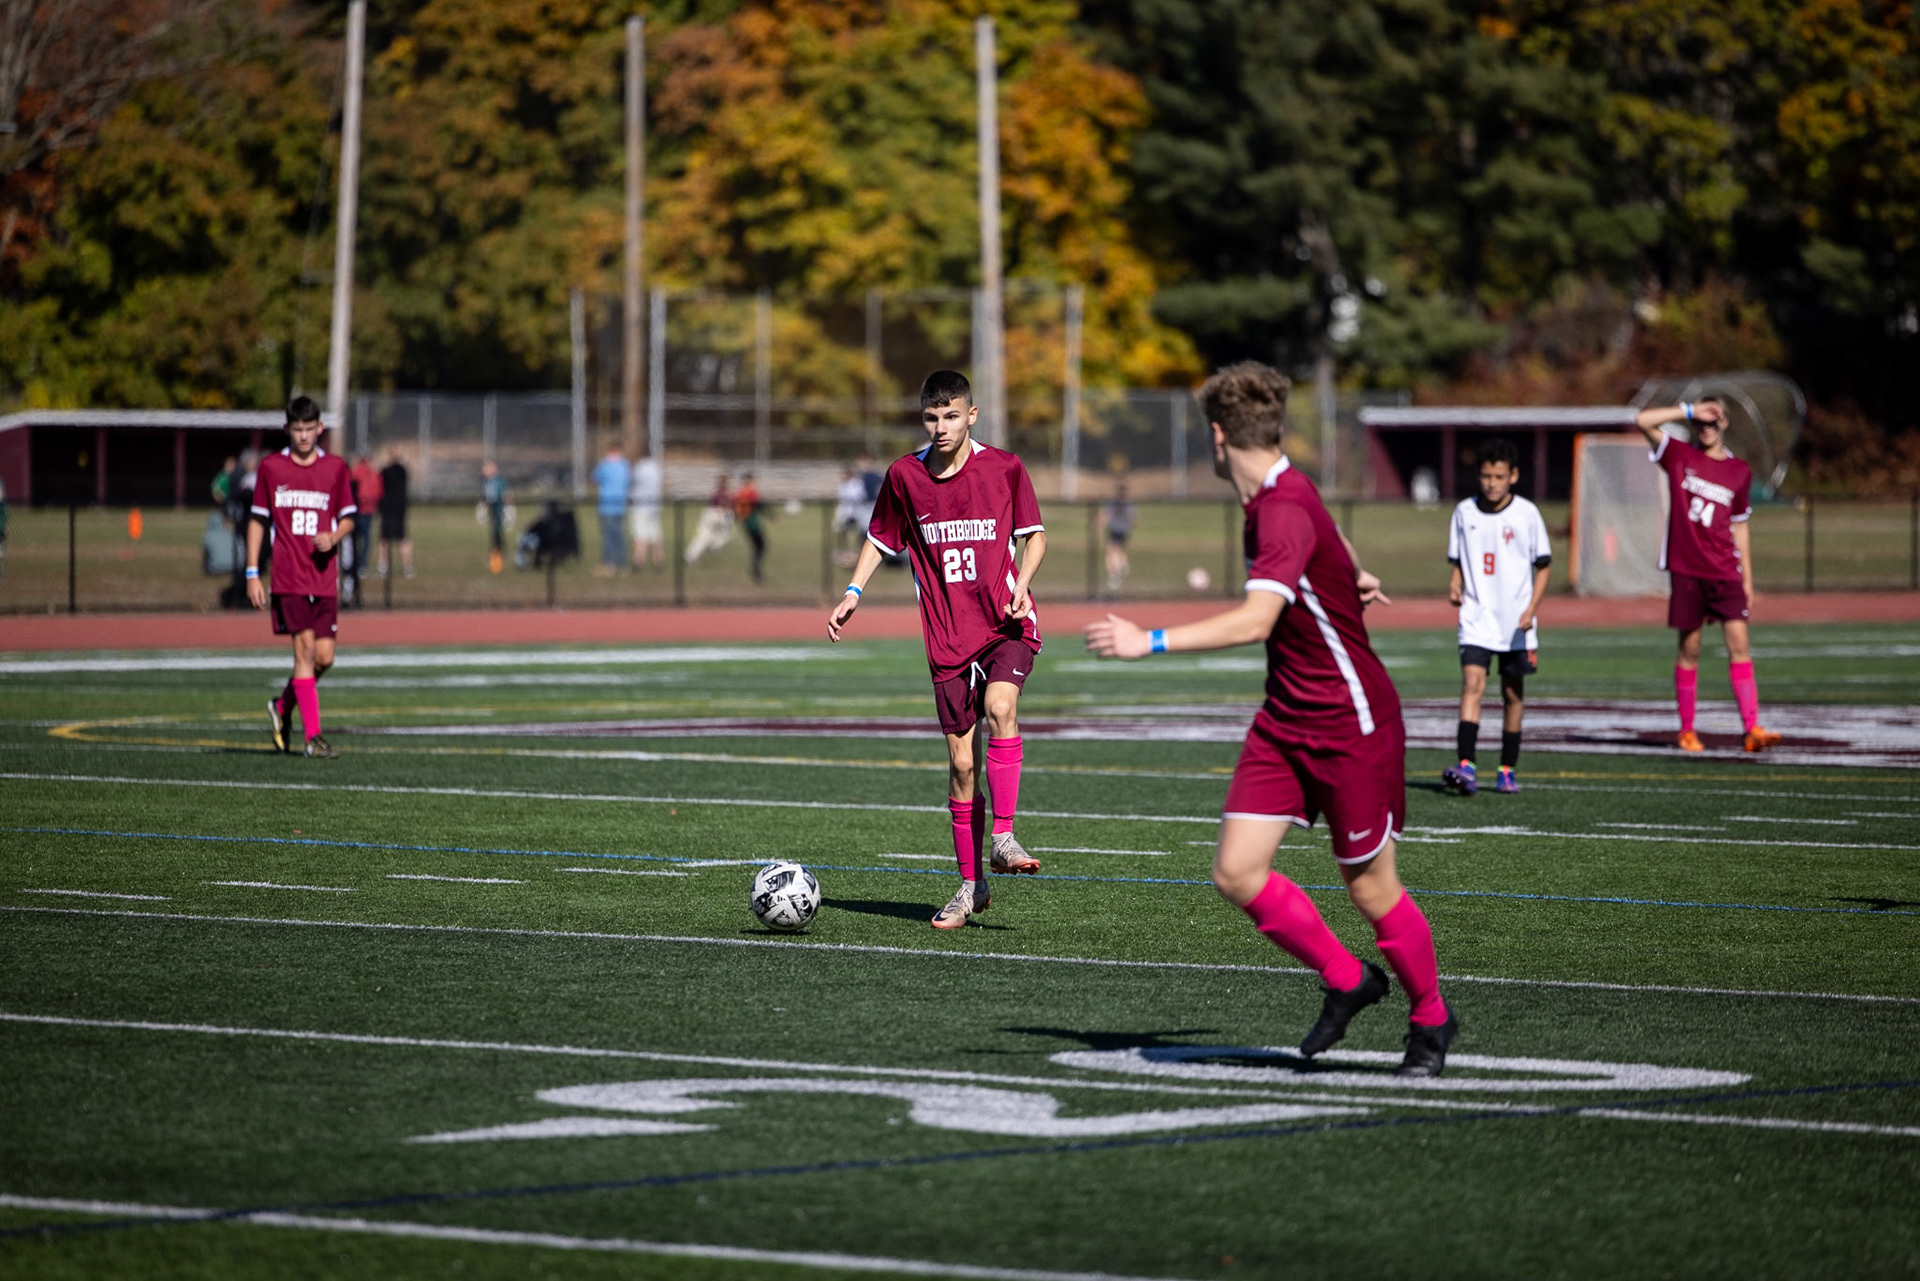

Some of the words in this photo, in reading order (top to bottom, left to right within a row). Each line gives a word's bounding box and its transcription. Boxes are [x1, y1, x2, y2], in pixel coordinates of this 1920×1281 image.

[292, 509, 319, 536] 22
[1687, 496, 1716, 528] 24
[943, 547, 978, 583] 23
[1483, 552, 1496, 576] 9
